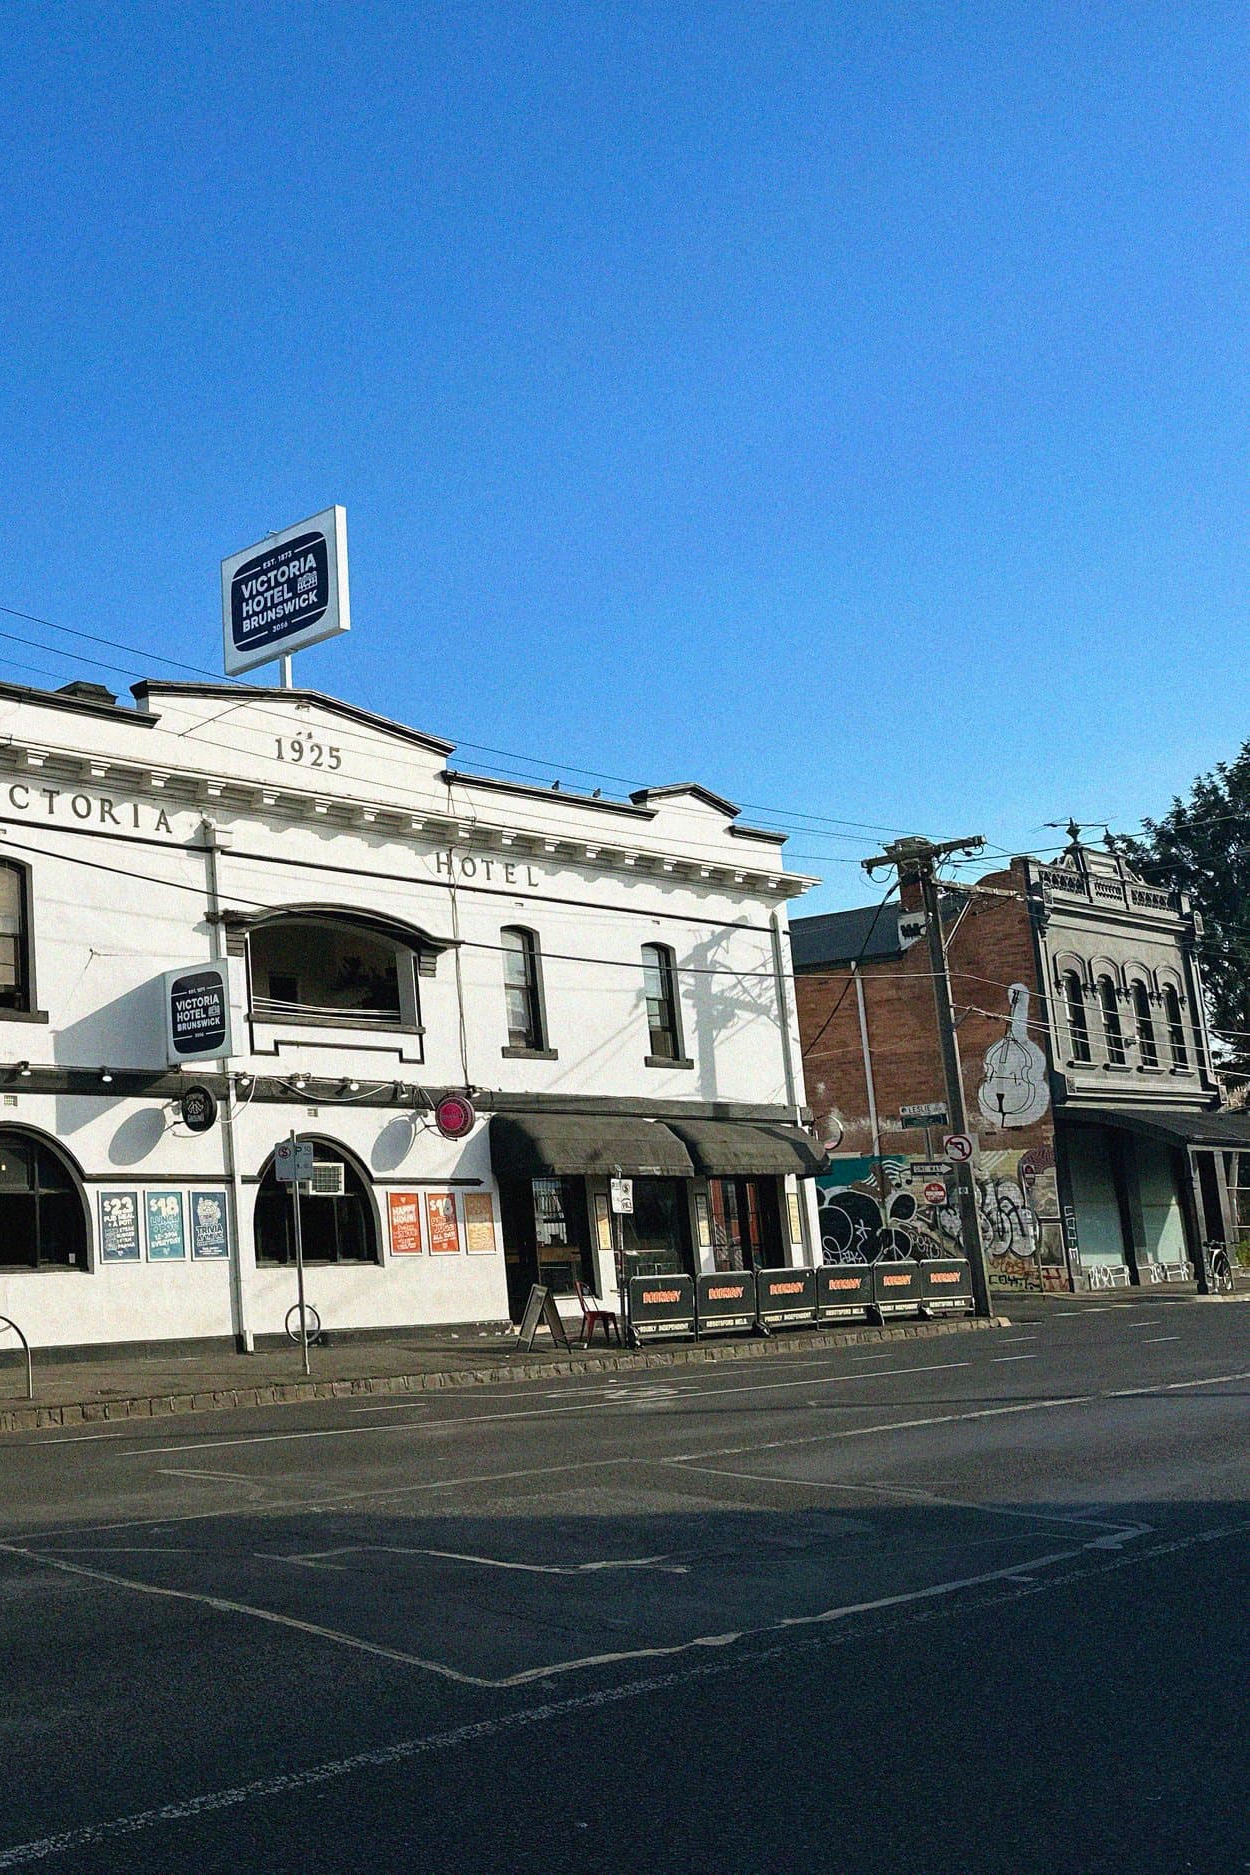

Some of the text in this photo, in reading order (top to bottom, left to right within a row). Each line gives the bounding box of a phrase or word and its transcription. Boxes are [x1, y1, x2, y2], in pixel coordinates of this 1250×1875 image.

[241, 553, 317, 599] VICTORIA
[242, 583, 293, 618] HOTEL
[242, 590, 318, 633] BRUNSWICK
[275, 737, 342, 770] 1925
[436, 851, 539, 888] HOTEL
[176, 993, 219, 1011] VICTORIA
[176, 1008, 206, 1022] HOTEL
[177, 1016, 221, 1032] BRUNSWICK
[908, 1102, 931, 1114] LESLIE
[103, 1196, 134, 1216] $23
[196, 1223, 223, 1235] TRIVIA
